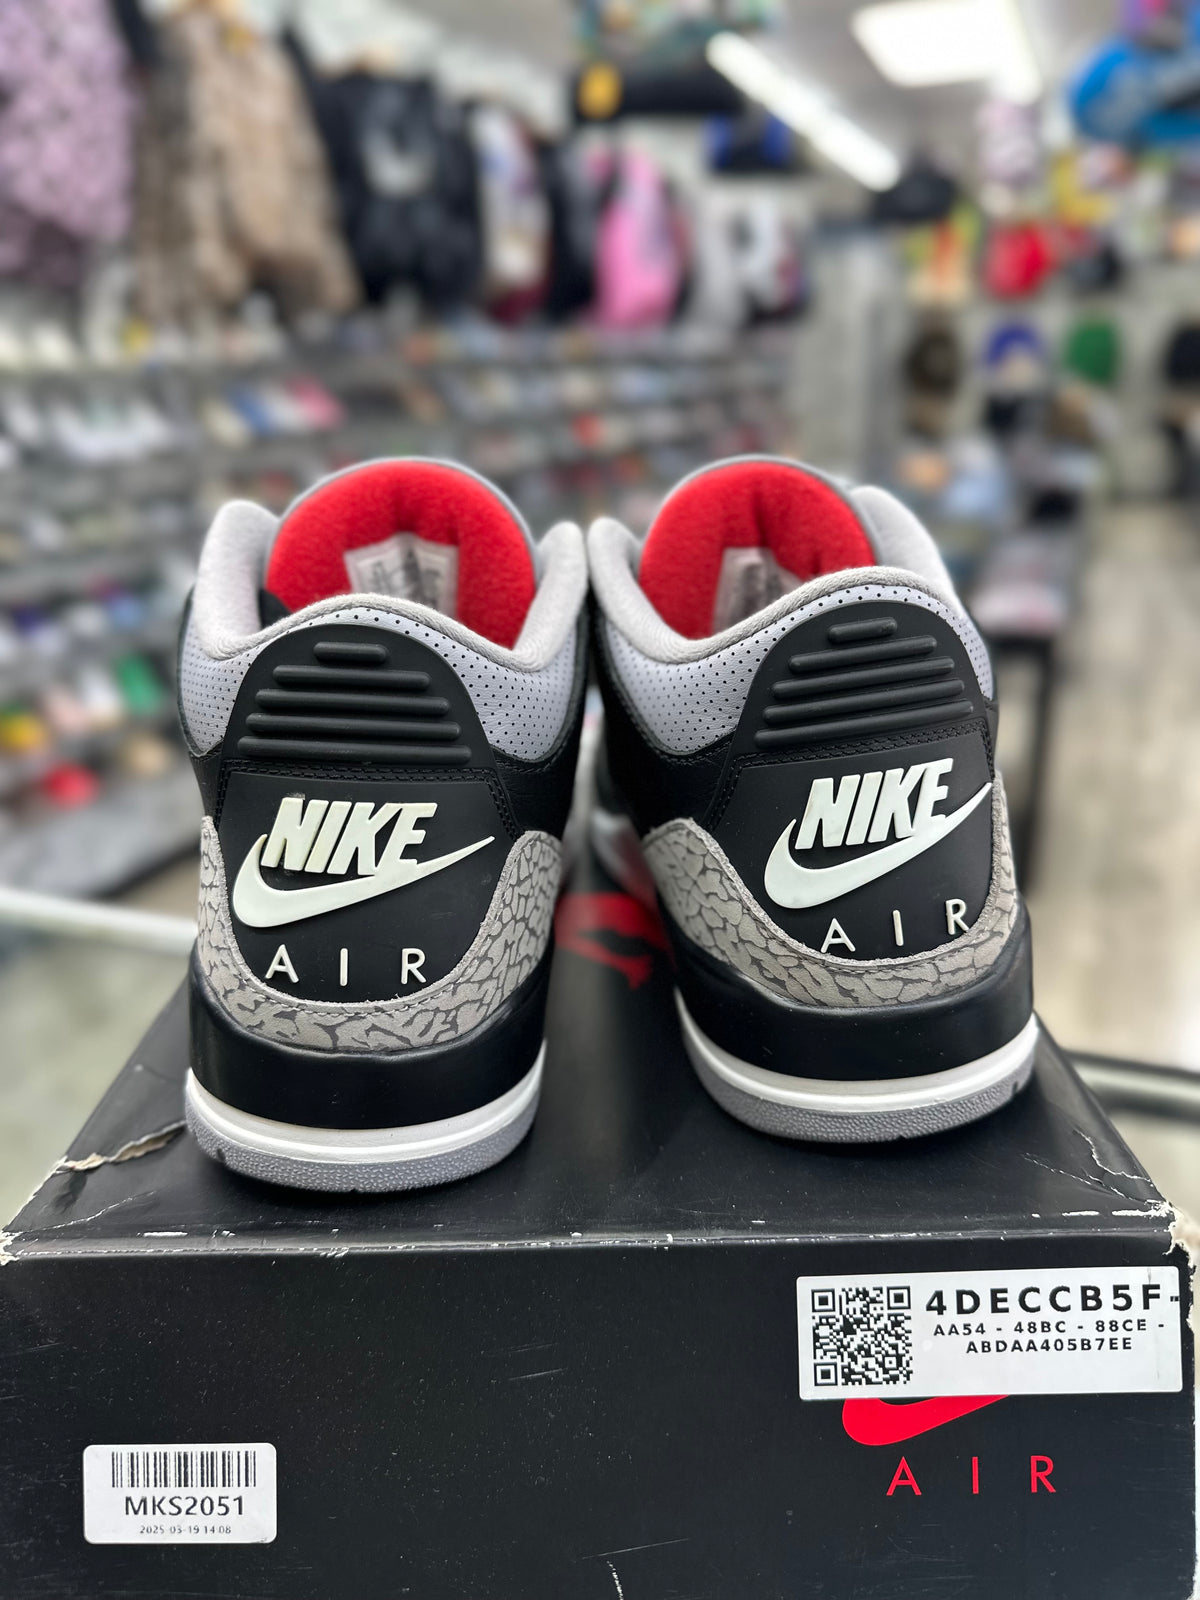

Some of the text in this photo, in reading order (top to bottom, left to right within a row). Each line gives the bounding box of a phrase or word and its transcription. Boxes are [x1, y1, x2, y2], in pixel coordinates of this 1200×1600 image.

[794, 757, 954, 850] NIKE
[261, 797, 438, 876] NIKE
[820, 898, 970, 954] AIR
[264, 943, 427, 987] AIR
[965, 1337, 1133, 1354] ABDAA405B7EE
[886, 1454, 1057, 1497] AIR
[124, 1495, 243, 1516] MKS2051
[139, 1524, 232, 1535] 202503-19 1408
